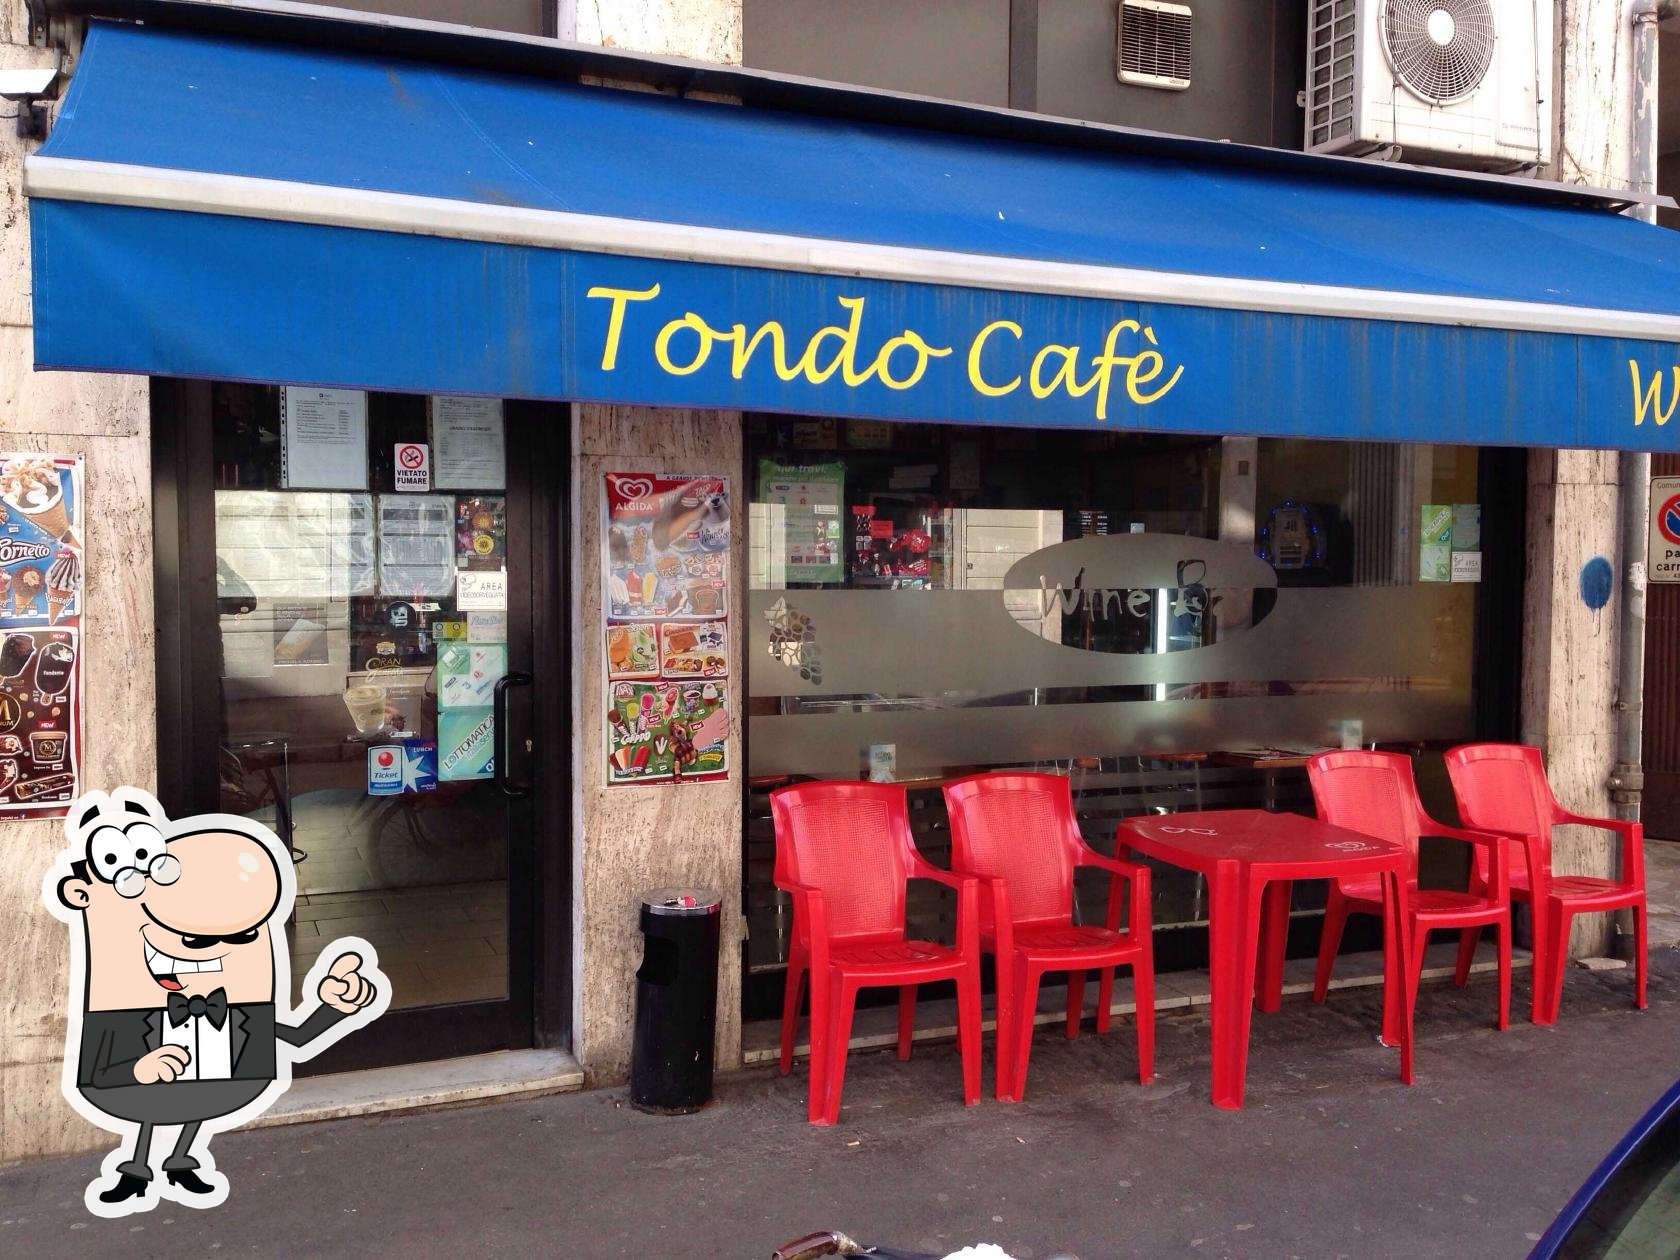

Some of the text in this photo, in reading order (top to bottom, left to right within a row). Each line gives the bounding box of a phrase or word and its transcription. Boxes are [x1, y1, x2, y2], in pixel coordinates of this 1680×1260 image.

[586, 283, 1185, 420] Tondo Cafè
[397, 477, 427, 485] FUMARE
[615, 502, 653, 511] ALGIDA
[480, 582, 503, 591] AREA
[1039, 565, 1151, 622] Wine
